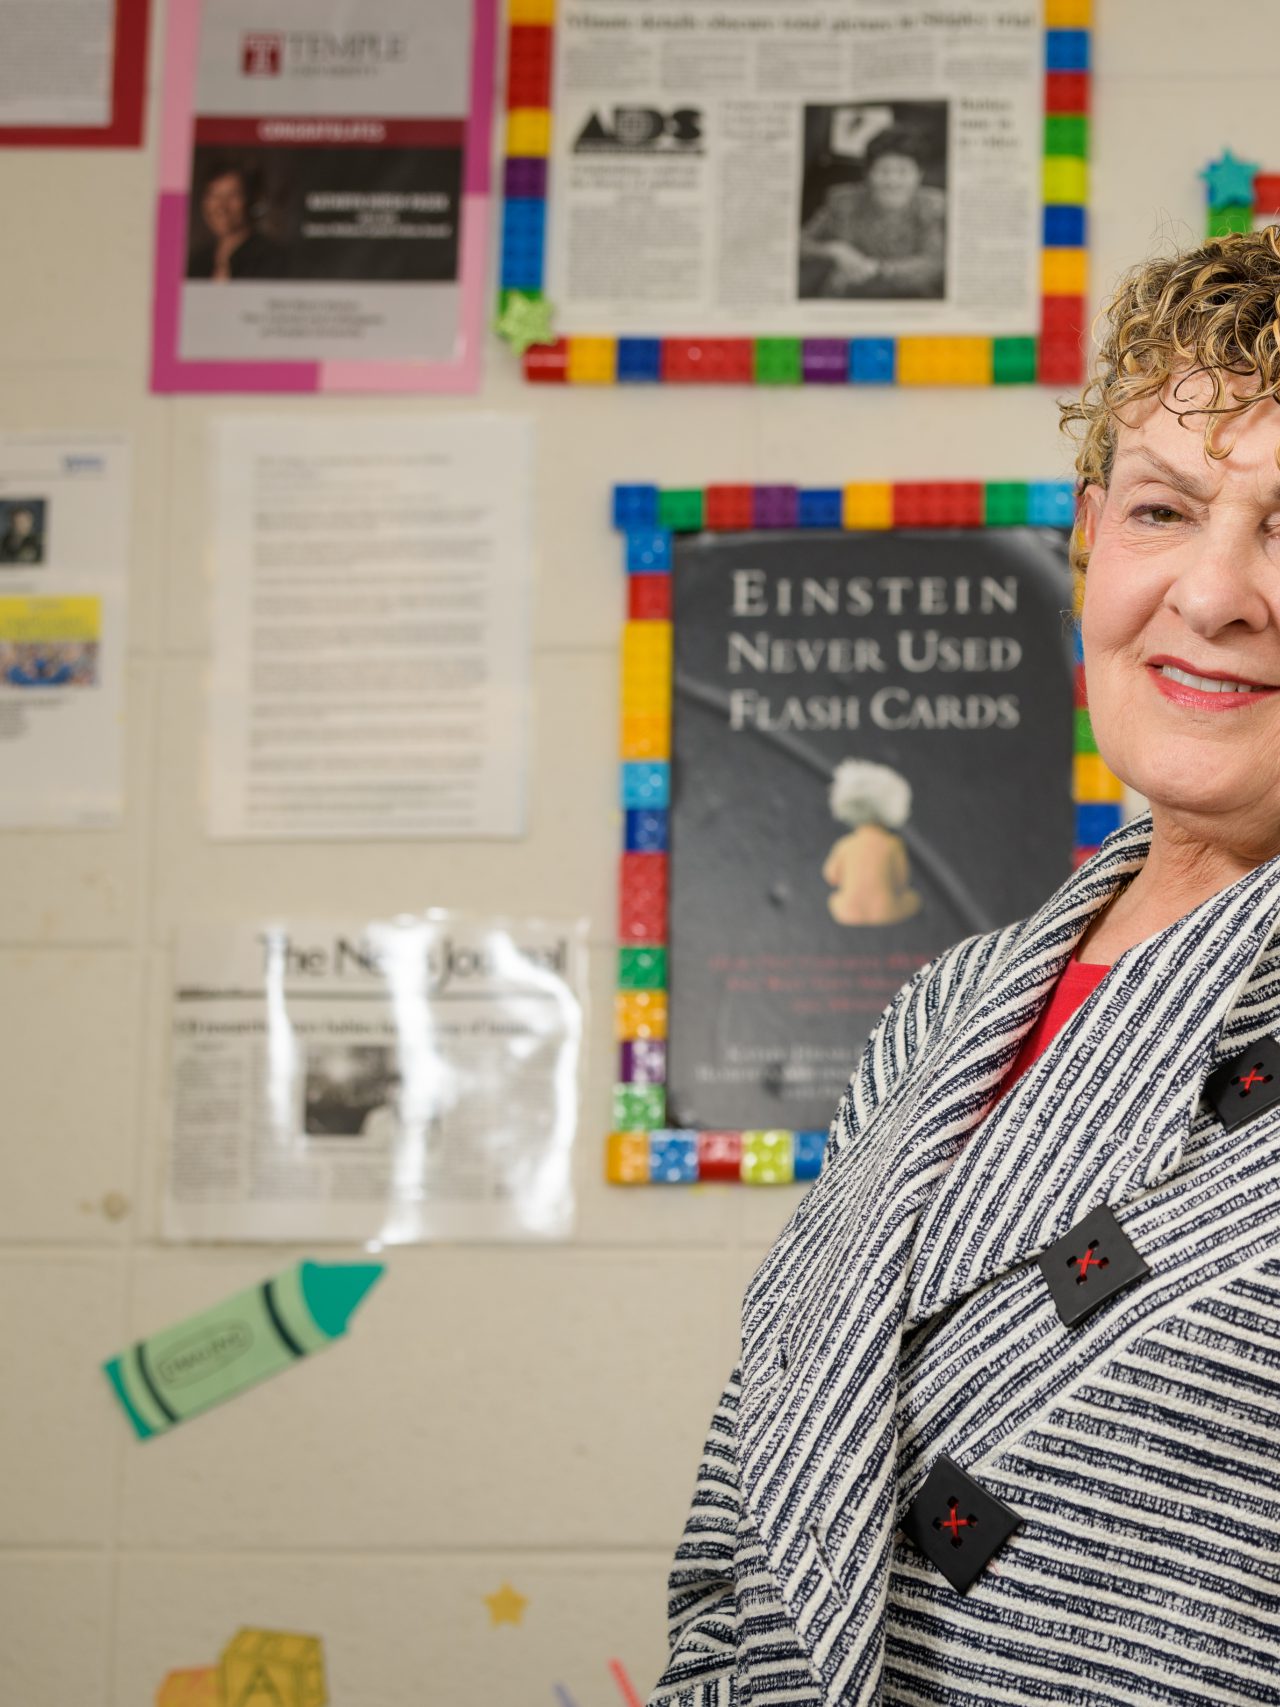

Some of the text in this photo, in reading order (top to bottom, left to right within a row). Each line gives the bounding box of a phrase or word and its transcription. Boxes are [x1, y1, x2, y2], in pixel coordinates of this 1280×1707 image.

[286, 33, 406, 60] TEMPLE
[731, 568, 1019, 618] EINSTEIN
[727, 629, 1023, 674] NEVER USED
[728, 686, 1021, 732] FLASH CARDS
